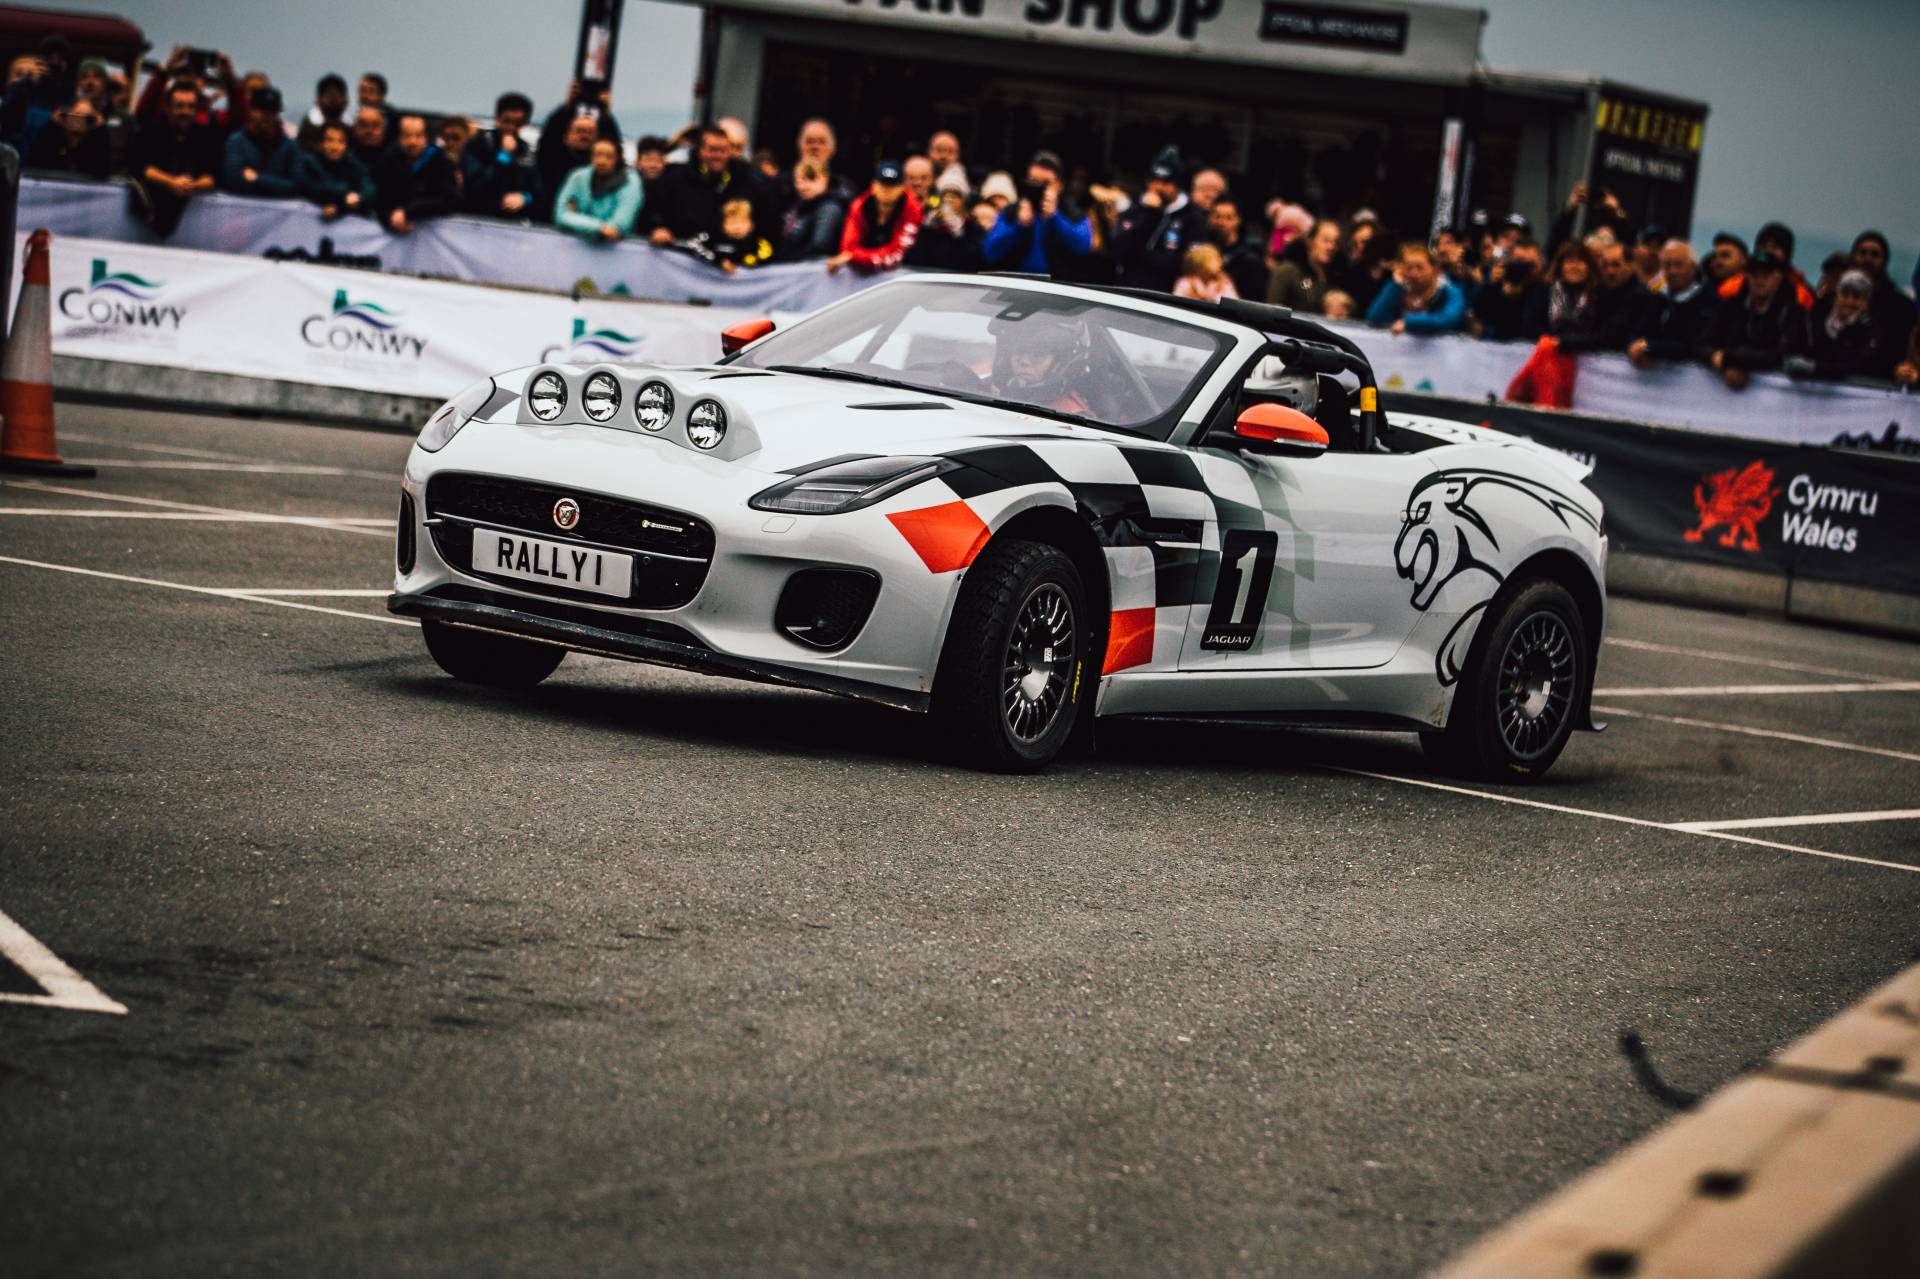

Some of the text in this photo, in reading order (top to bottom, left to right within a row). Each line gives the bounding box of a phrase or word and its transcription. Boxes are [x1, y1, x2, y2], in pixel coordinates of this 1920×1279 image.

[58, 287, 187, 329] CONWY
[301, 313, 428, 358] CONWY
[1787, 473, 1878, 516] Cymru
[1782, 511, 1858, 553] Wales
[1229, 546, 1258, 624] 1
[1206, 634, 1251, 645] JAGUAR
